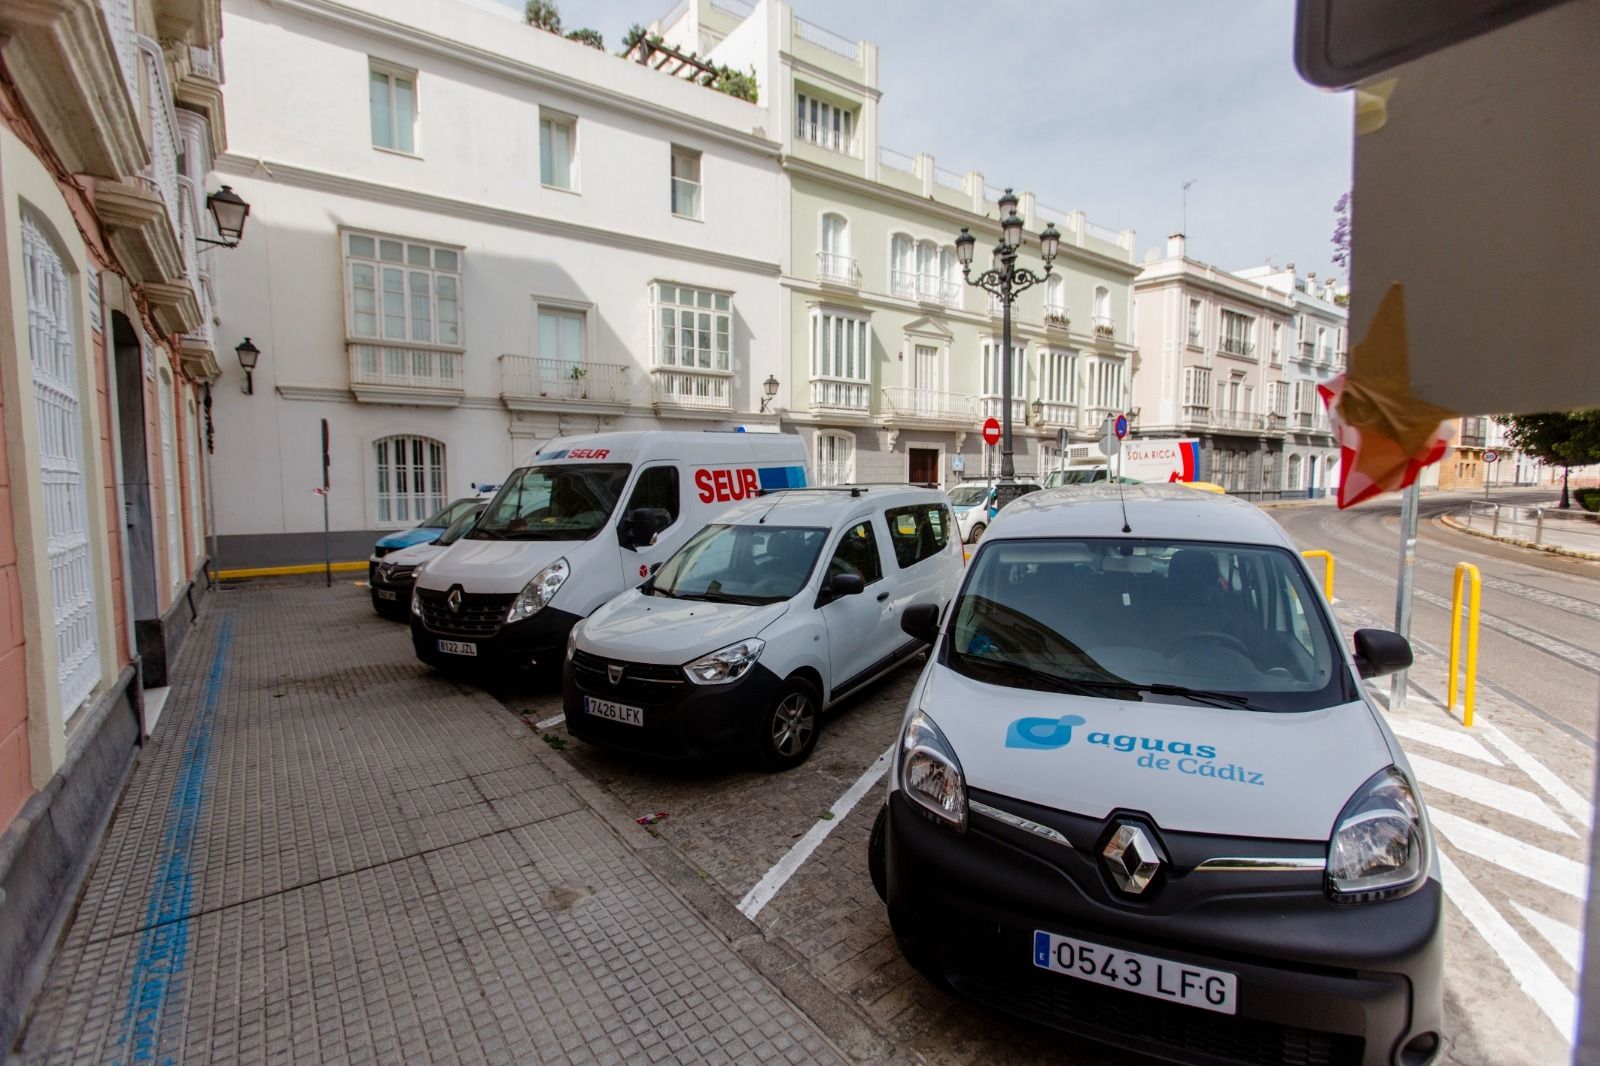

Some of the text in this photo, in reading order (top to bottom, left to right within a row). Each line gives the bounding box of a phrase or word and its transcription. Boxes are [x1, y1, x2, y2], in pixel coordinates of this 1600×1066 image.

[567, 449, 611, 460] SEUR
[1127, 450, 1176, 460] SOLA RICCA
[695, 469, 759, 503] SEUR
[590, 700, 640, 724] 7426 LFK
[1087, 732, 1217, 759] aguas
[1137, 753, 1265, 786] de Cádiz
[1057, 942, 1226, 1005] 0543 LFG
